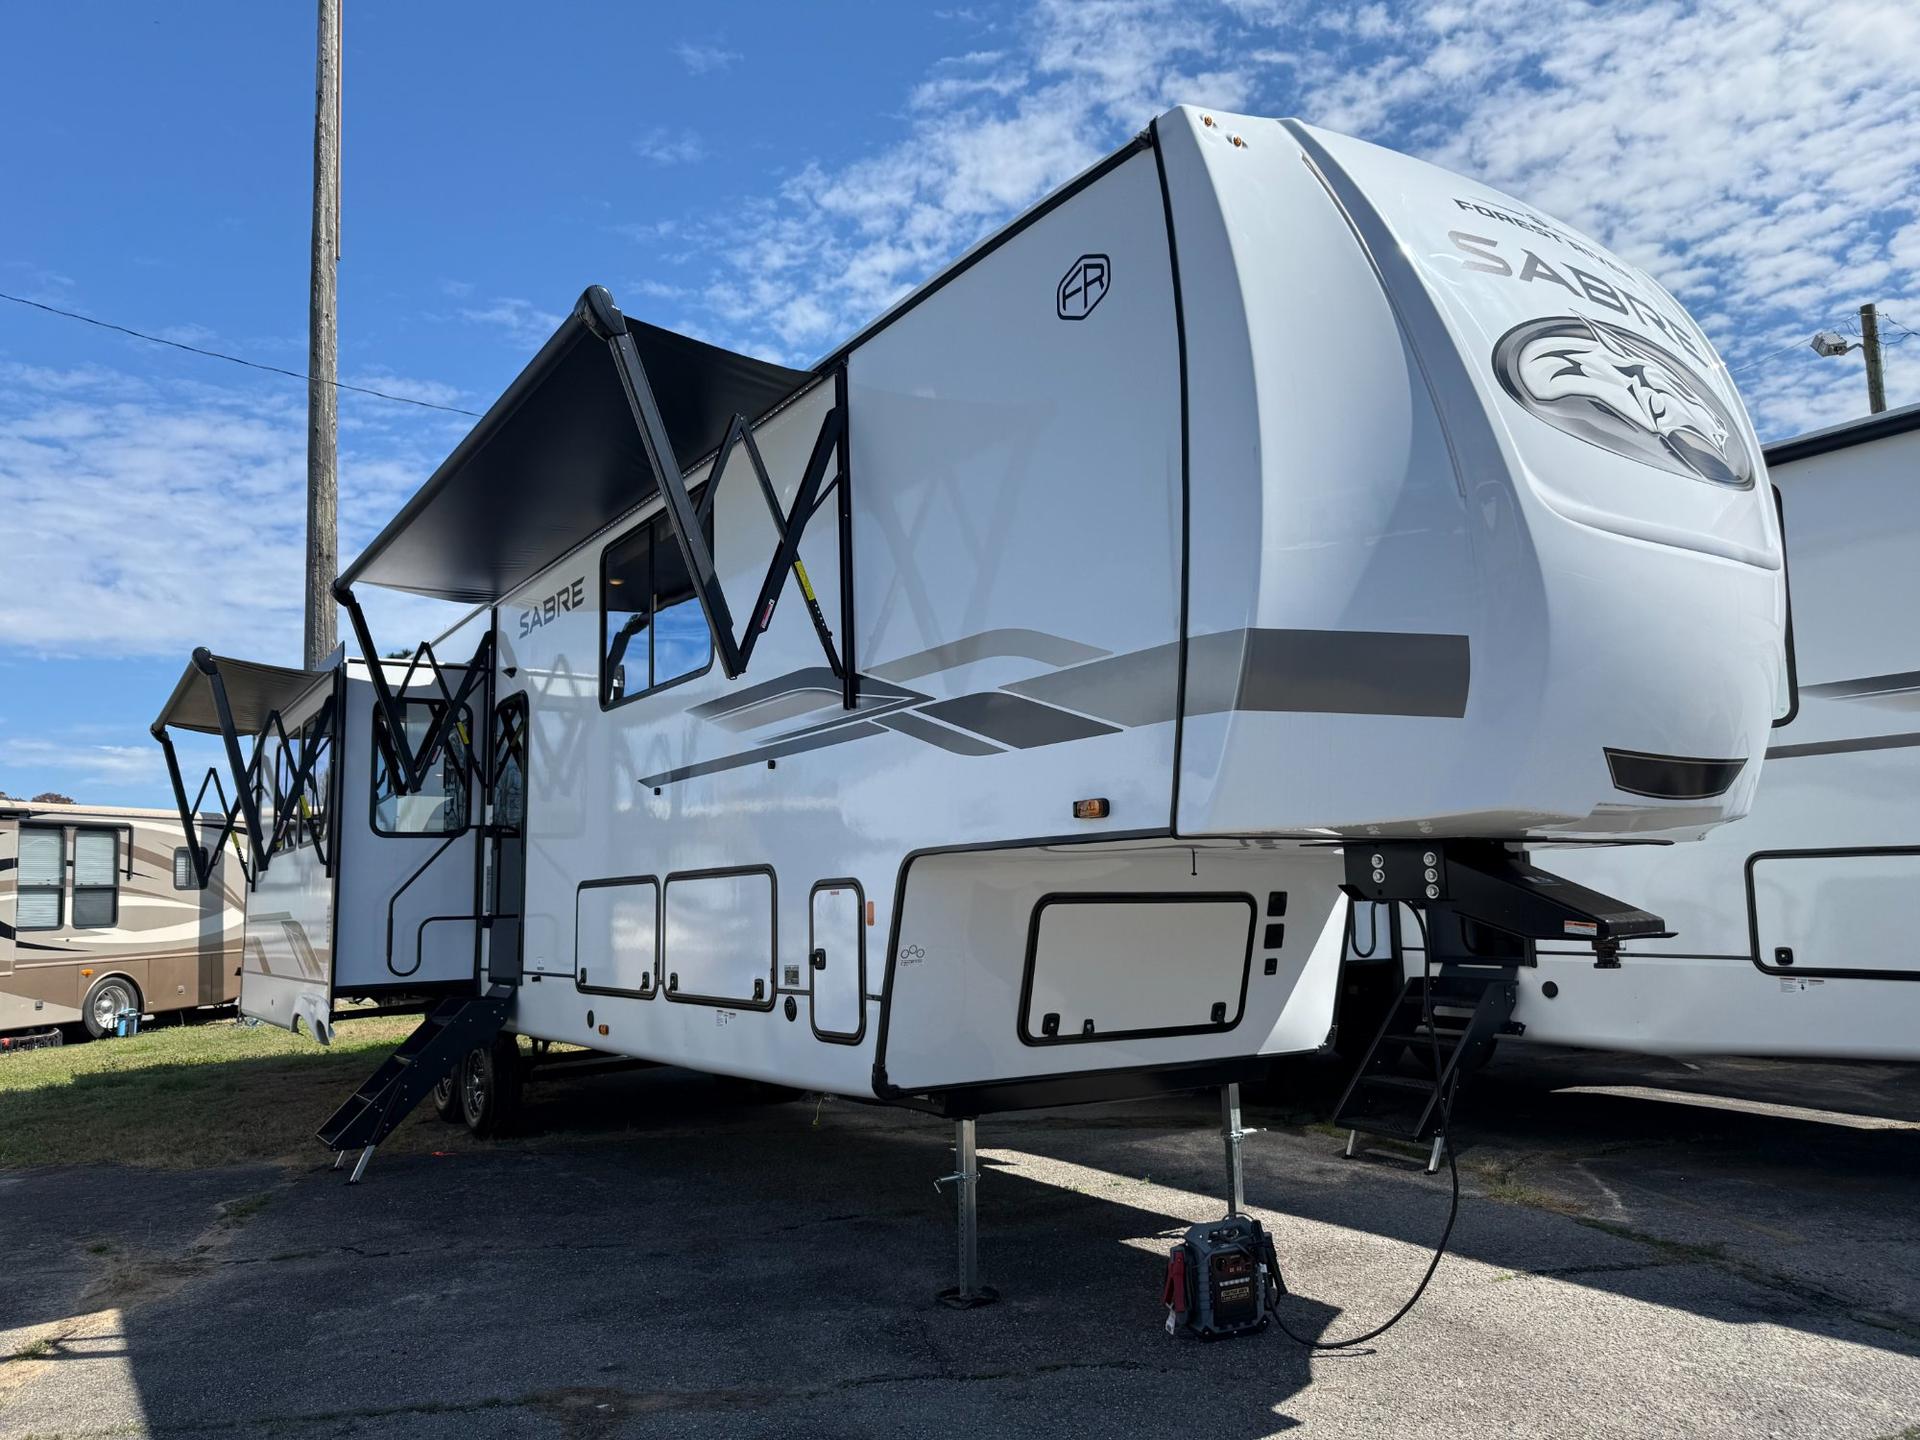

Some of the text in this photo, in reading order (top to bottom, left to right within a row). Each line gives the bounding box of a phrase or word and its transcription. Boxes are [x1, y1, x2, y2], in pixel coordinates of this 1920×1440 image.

[1452, 198, 1563, 243] FOREST
[1448, 230, 1709, 368] SABRE
[518, 576, 585, 640] SABRE
